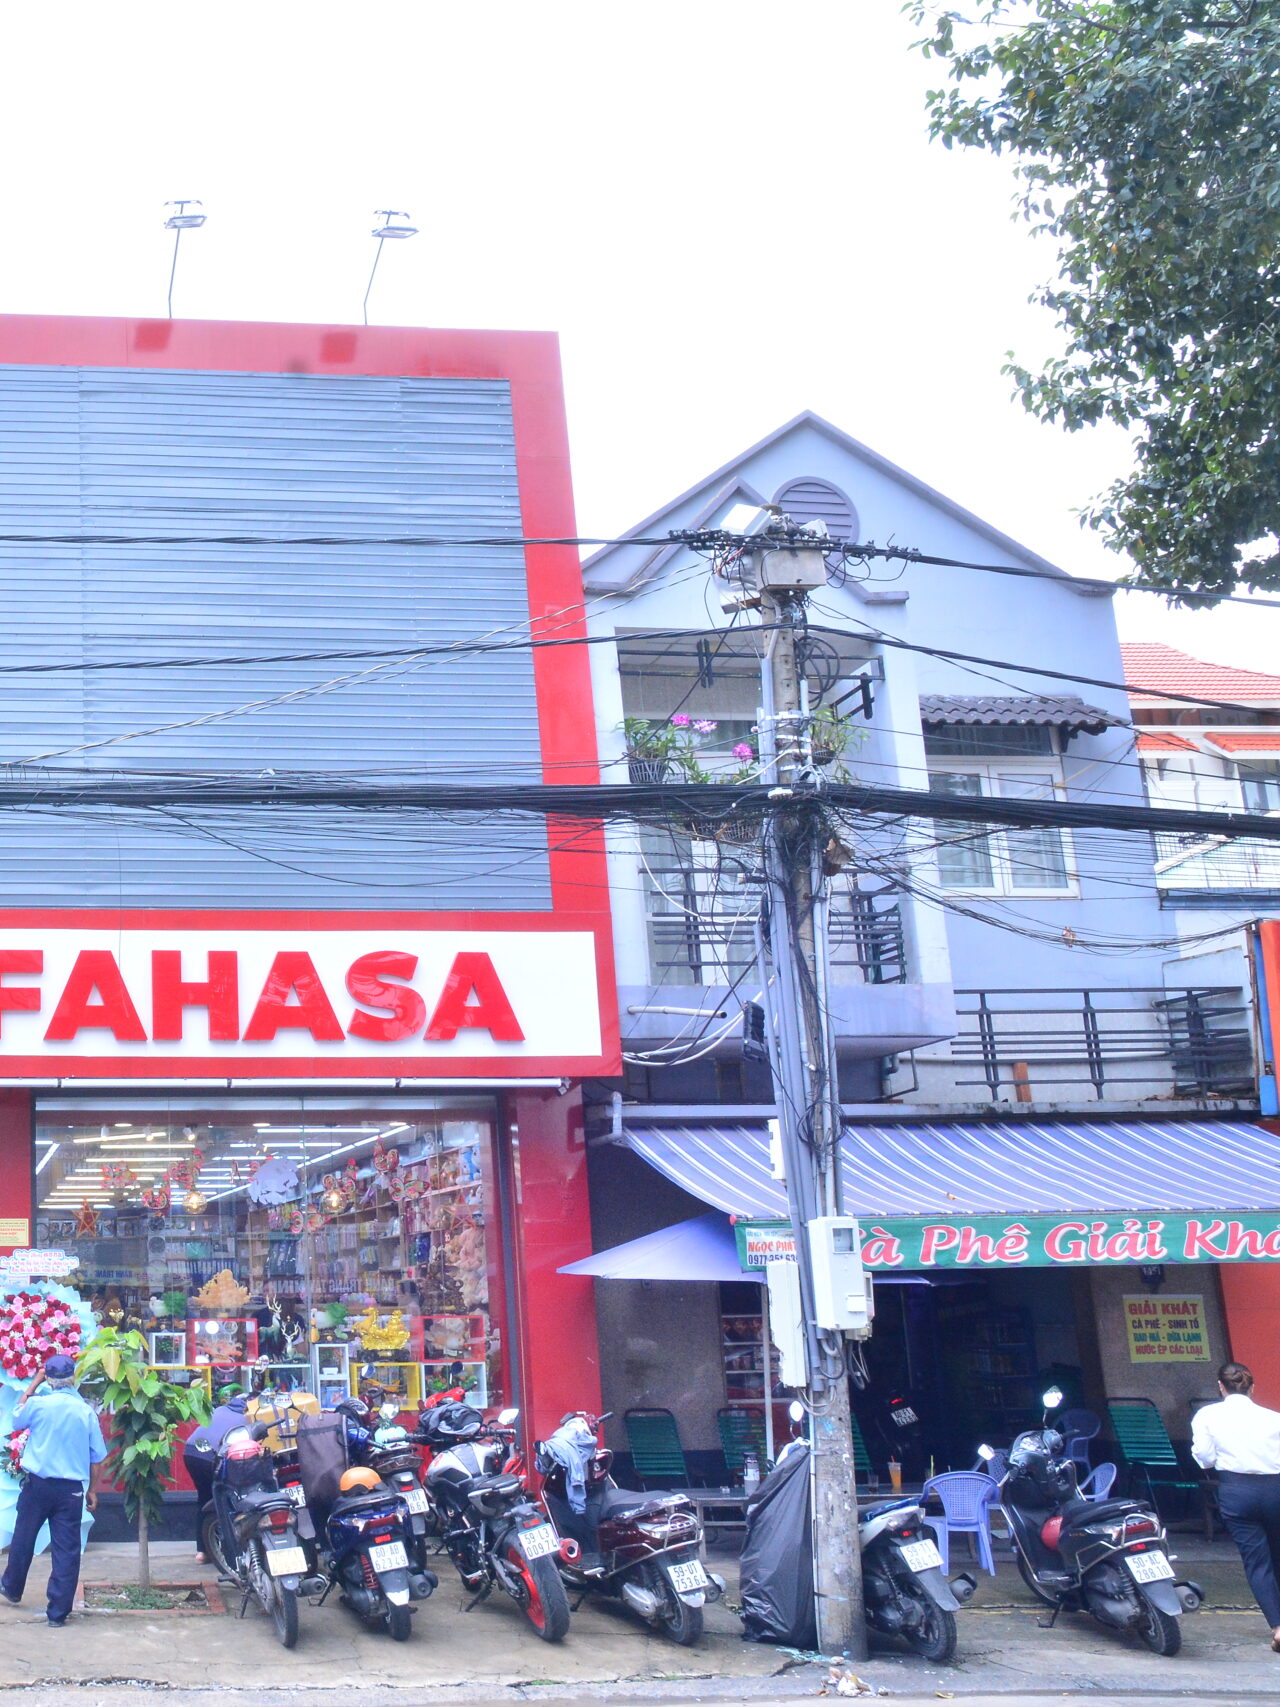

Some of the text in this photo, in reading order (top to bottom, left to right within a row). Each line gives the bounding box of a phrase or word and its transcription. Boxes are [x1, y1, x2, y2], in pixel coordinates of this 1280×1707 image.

[748, 1240, 773, 1254] NGỌC
[859, 1226, 904, 1266] à
[919, 1223, 1031, 1265] Phê
[1044, 1219, 1168, 1262] Giải
[1128, 1300, 1198, 1315] GIẢI KHÁT
[1132, 1318, 1143, 1329] CÀ
[1144, 1318, 1161, 1329] PHÊ
